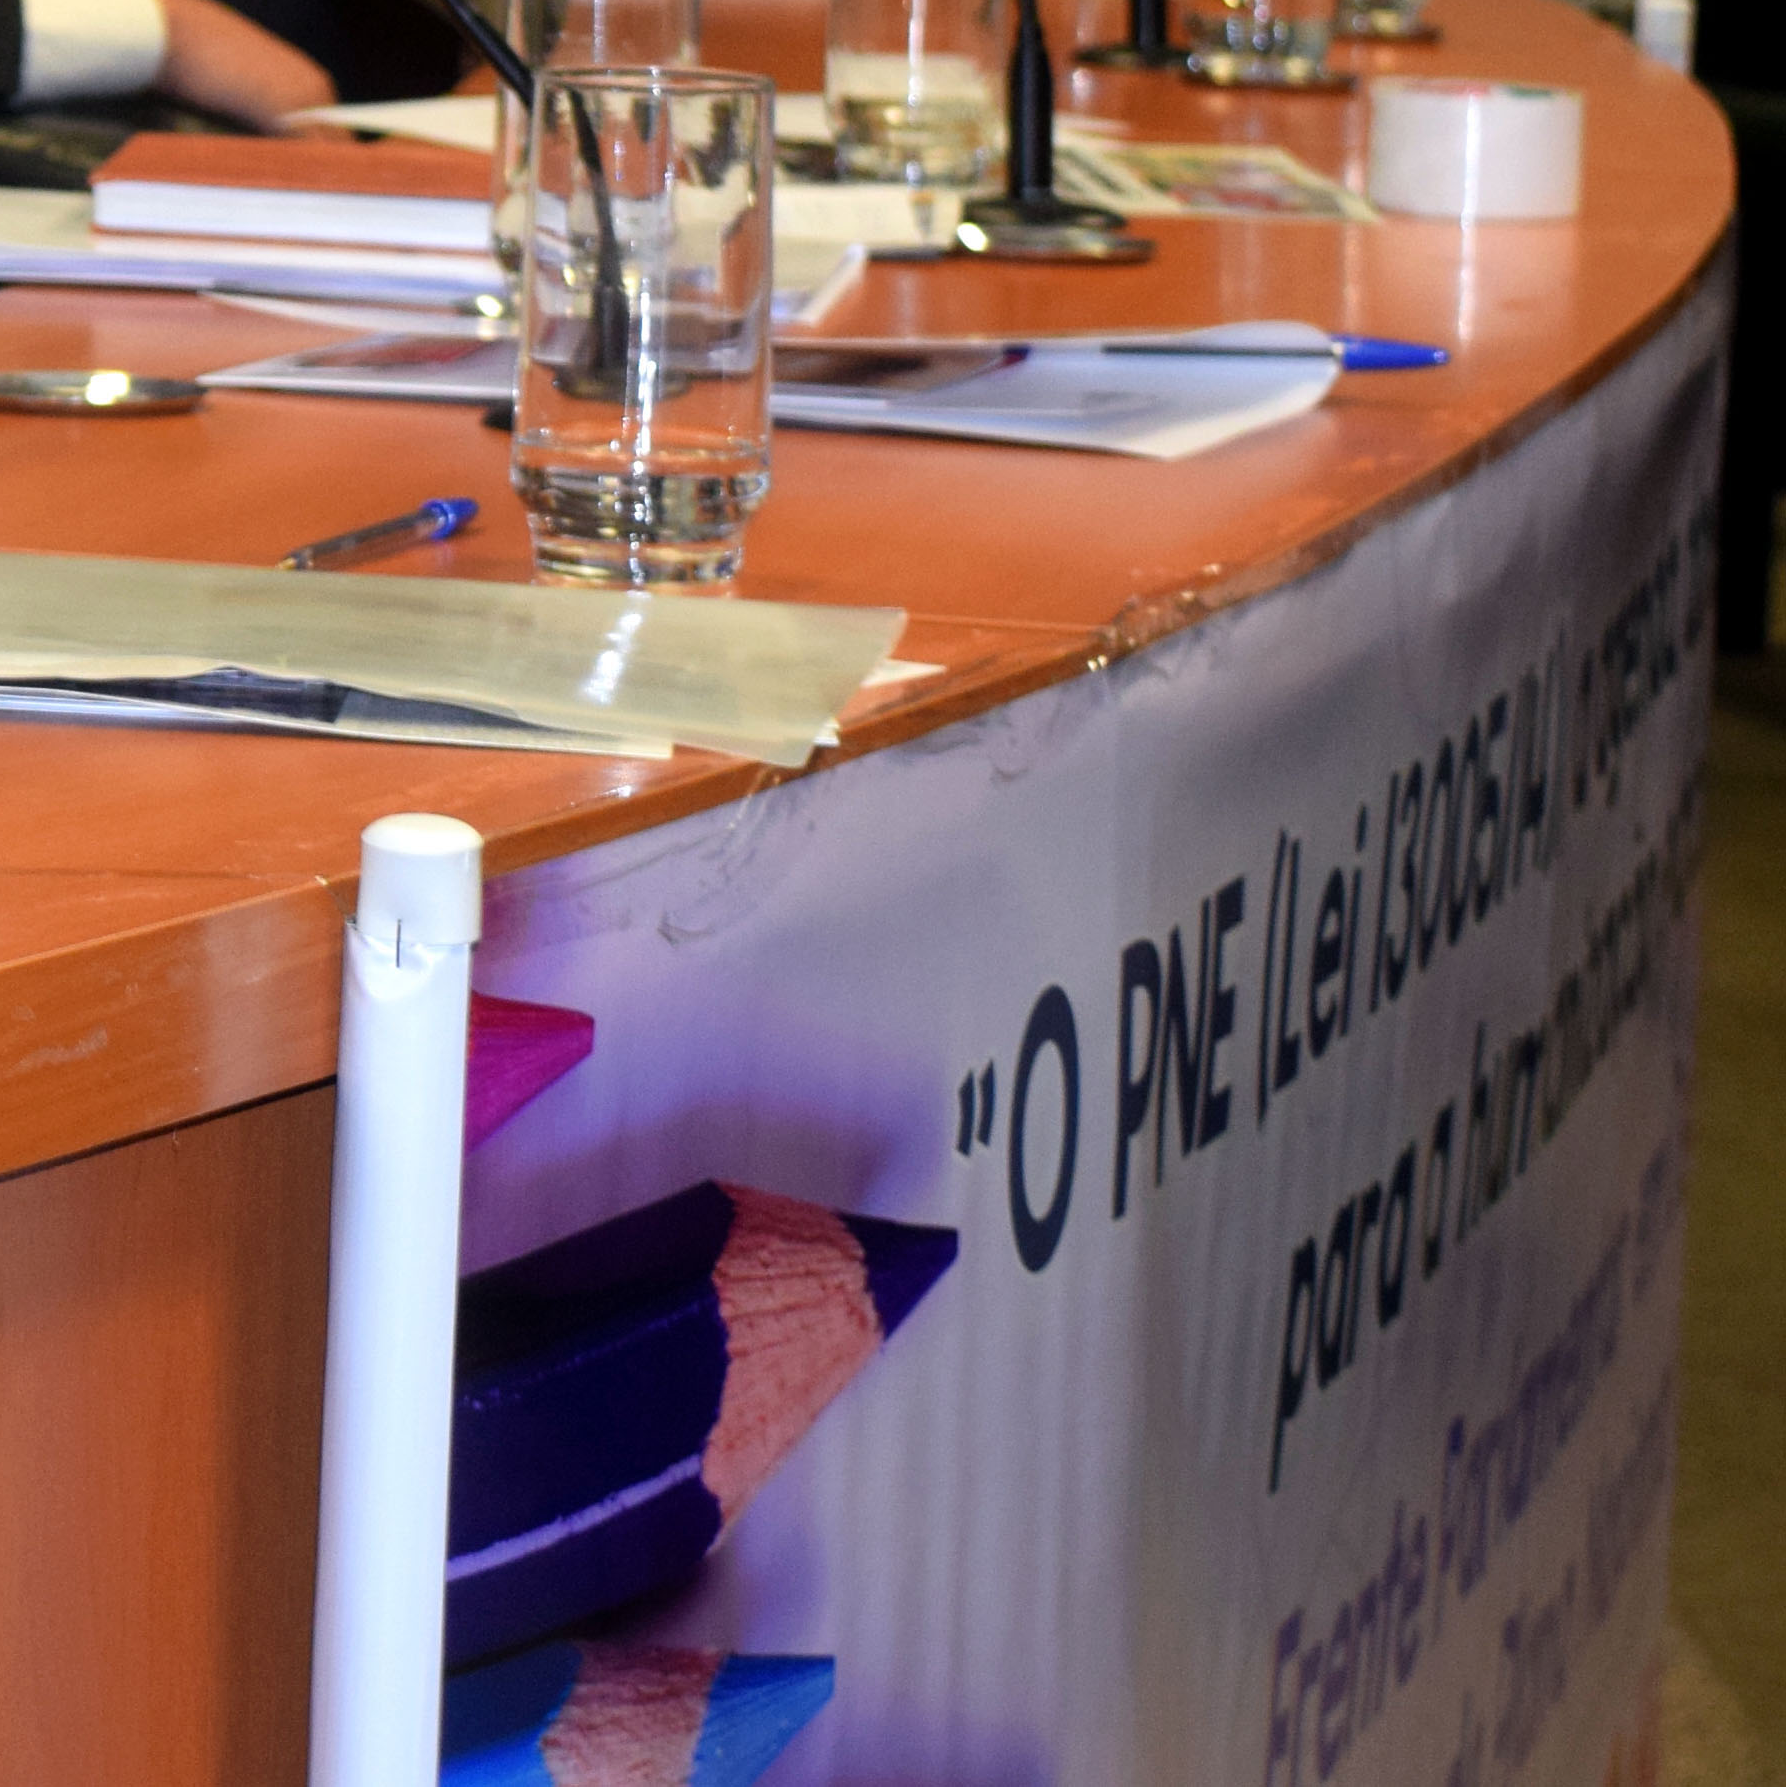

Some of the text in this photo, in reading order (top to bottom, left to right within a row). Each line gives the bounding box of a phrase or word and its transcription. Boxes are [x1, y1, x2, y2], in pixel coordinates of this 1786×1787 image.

[1111, 874, 1246, 1222] PNE
[1258, 802, 1369, 1131] (Lei
[1269, 1138, 1417, 1496] para
